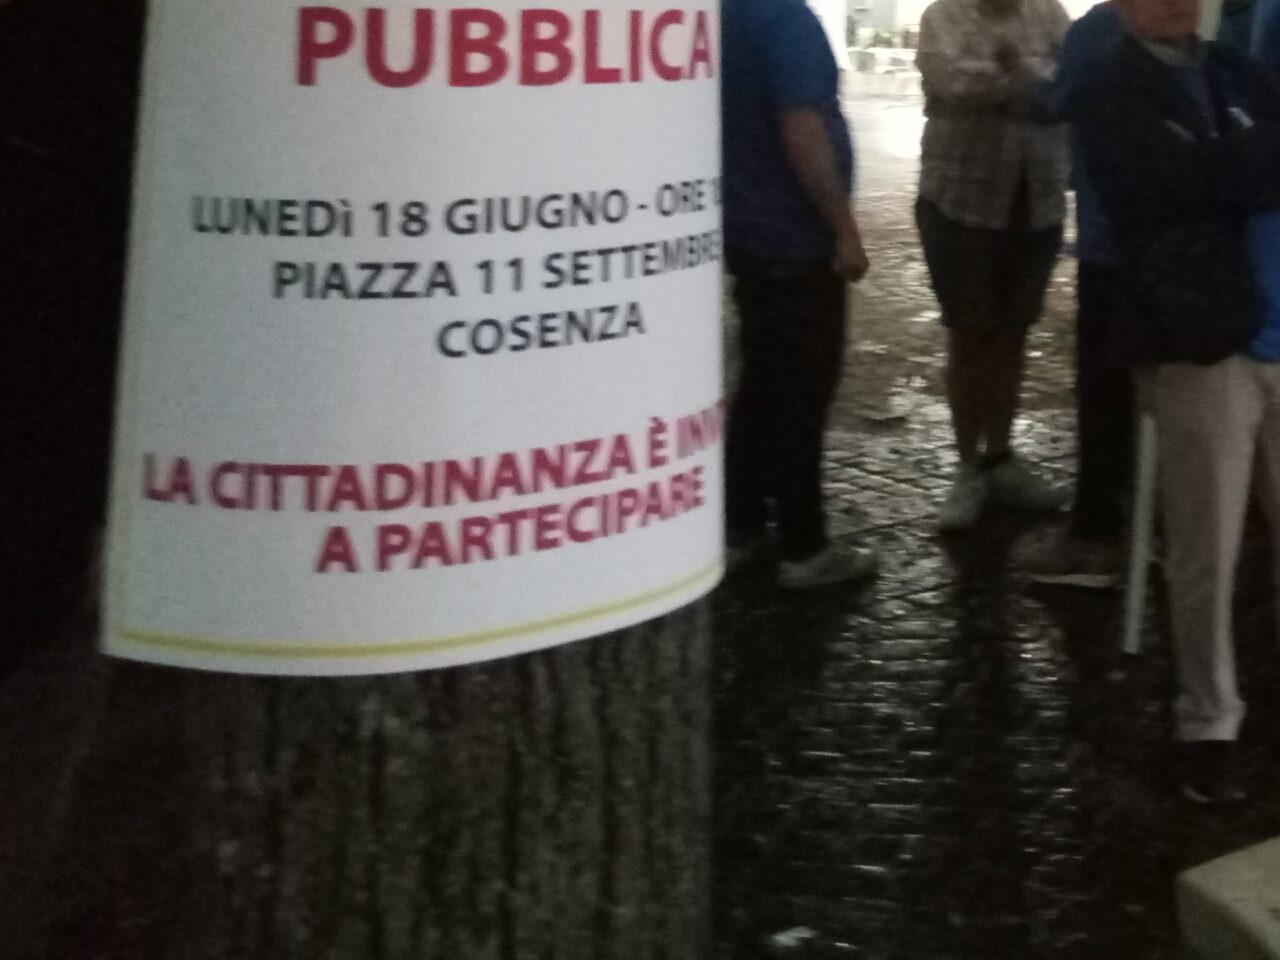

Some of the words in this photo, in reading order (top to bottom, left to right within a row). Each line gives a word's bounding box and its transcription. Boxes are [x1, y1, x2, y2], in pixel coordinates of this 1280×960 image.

[296, 5, 713, 88] PUBBLICA
[371, 201, 429, 238] 18
[444, 189, 628, 237] GIUGNO
[655, 178, 706, 218] ORE
[271, 261, 458, 300] PIAZZA
[477, 257, 525, 295] 11
[436, 301, 647, 359] COSENZA
[143, 452, 198, 506] LA
[209, 432, 635, 513] CITTADINANZA
[315, 526, 358, 574] A
[376, 465, 705, 572] PARTECIPARE
